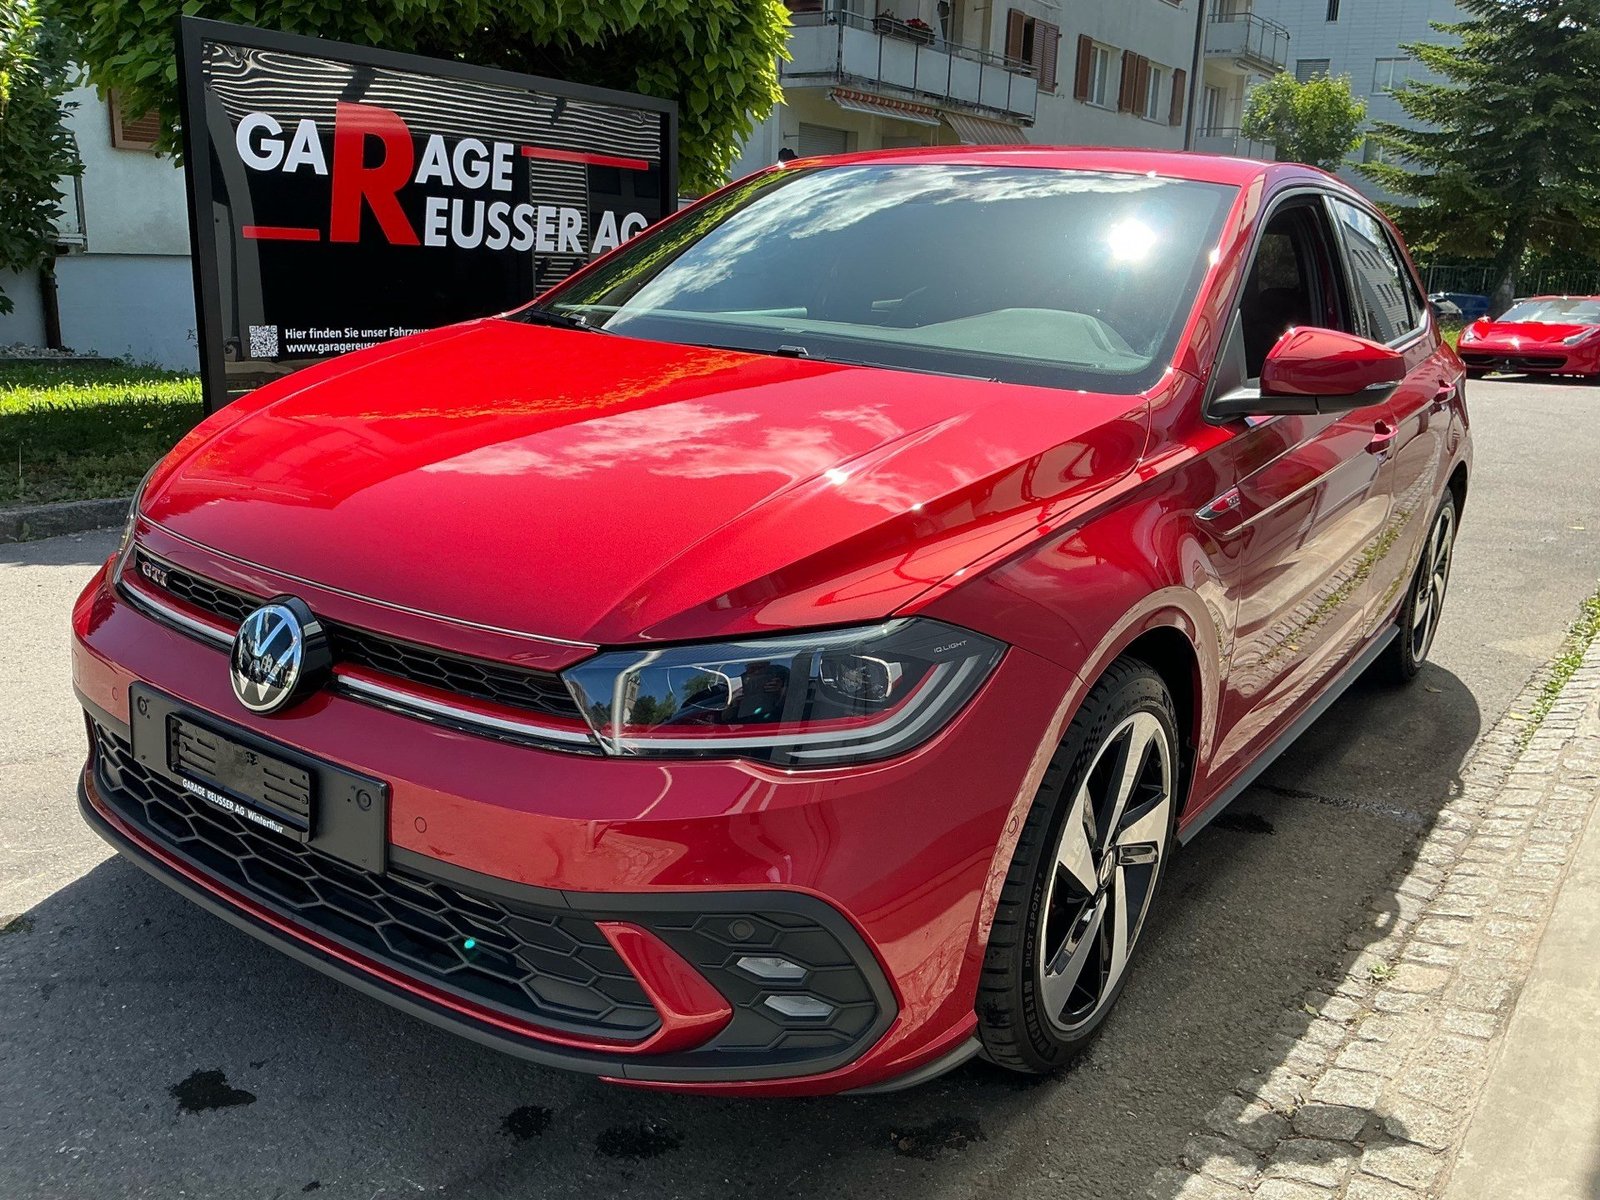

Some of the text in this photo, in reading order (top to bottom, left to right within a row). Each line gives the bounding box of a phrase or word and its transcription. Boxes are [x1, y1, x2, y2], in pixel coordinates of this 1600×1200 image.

[235, 101, 514, 246] GARAGE
[591, 210, 649, 254] AG
[285, 328, 307, 339] Hier
[309, 327, 342, 339] finden
[344, 327, 359, 338] Sie
[361, 328, 388, 338] unser
[142, 561, 167, 588] GTI
[182, 778, 284, 834] GARAGE REUSSER AG Winterthur
[1029, 884, 1042, 928] SPORT
[1025, 932, 1034, 968] PILOT
